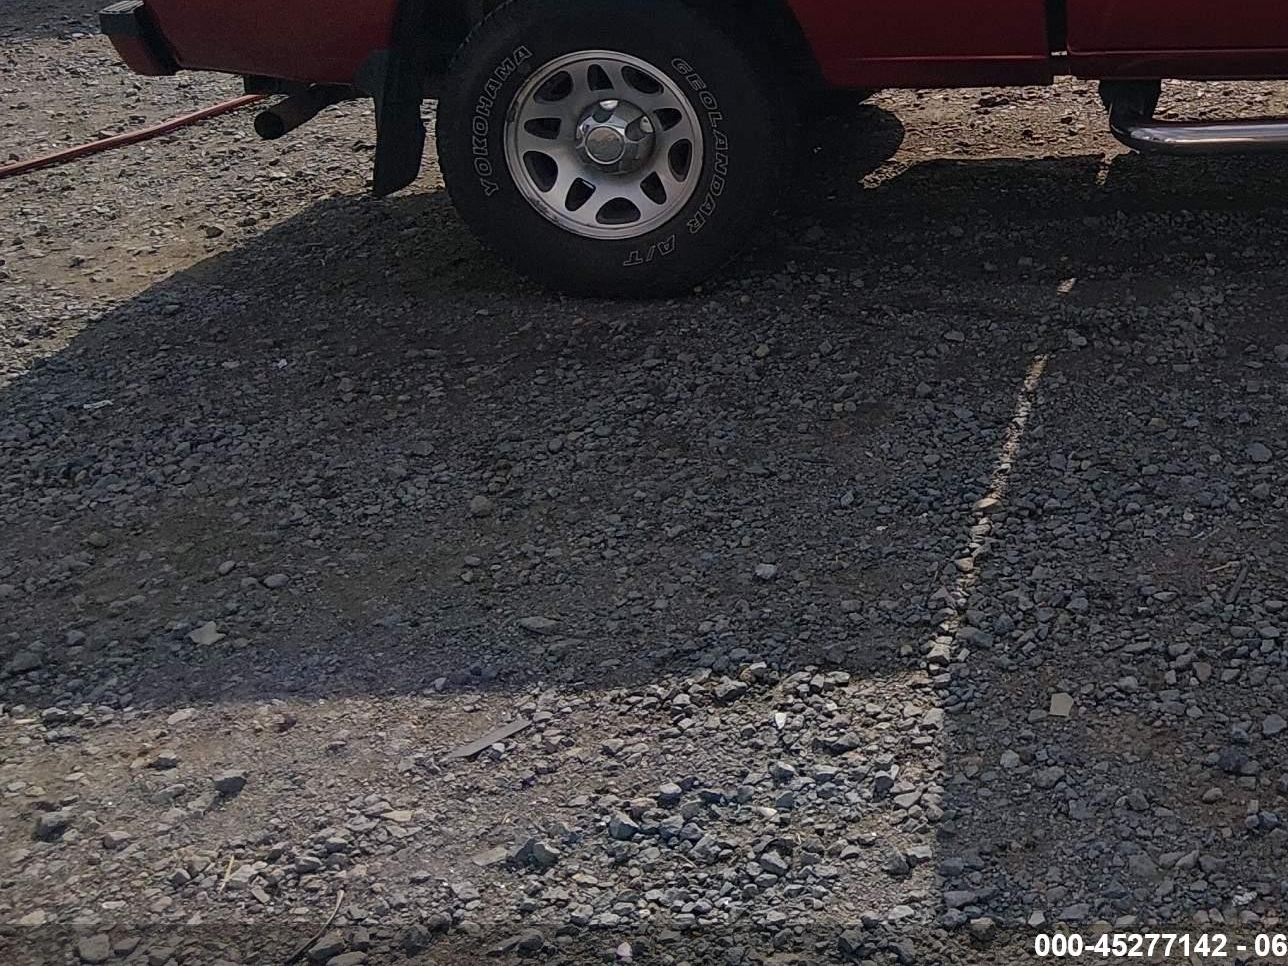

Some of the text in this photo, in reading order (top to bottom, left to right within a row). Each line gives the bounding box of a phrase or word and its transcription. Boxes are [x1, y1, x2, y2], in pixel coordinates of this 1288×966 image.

[470, 45, 535, 198] YOKOHAMA
[622, 57, 730, 268] GEOLANDAR A/T
